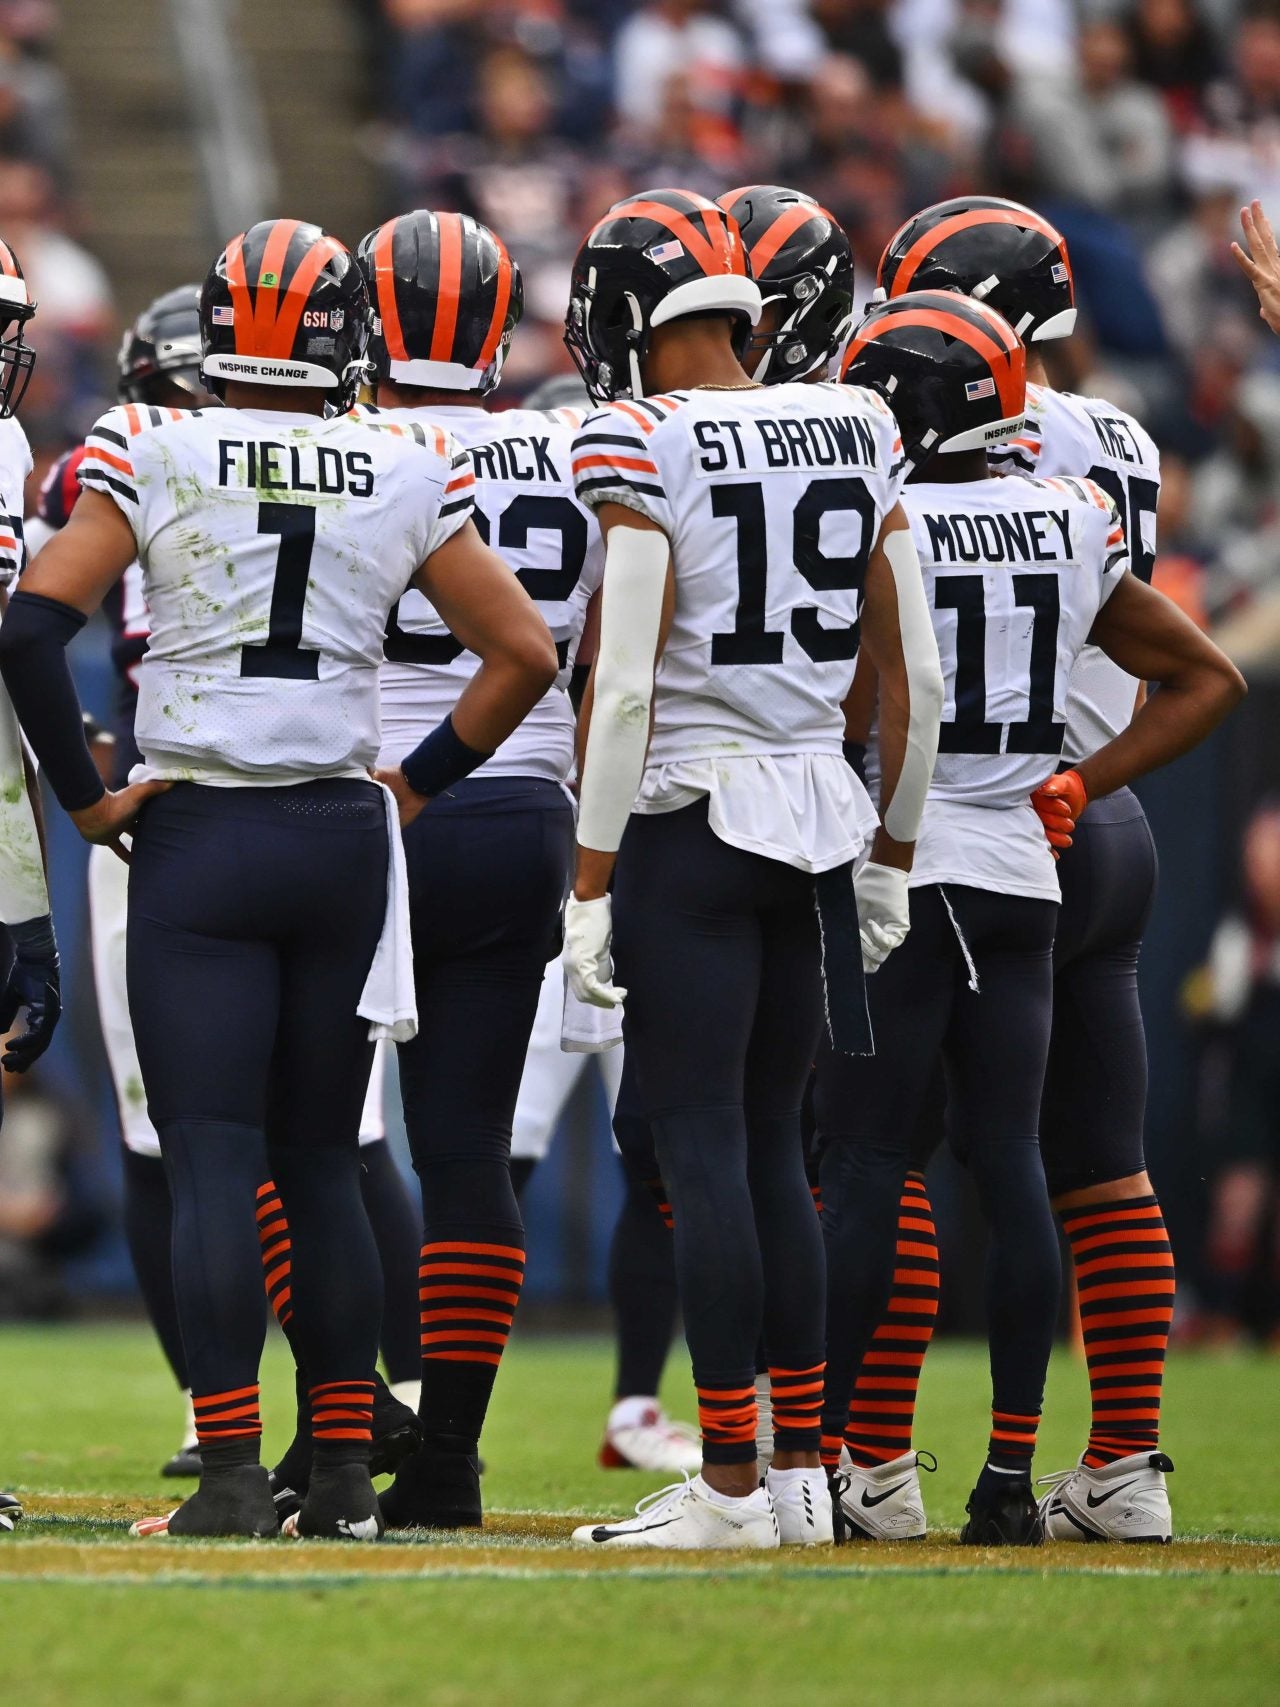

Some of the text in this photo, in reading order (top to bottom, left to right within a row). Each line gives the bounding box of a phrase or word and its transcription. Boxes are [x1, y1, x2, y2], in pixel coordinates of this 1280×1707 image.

[303, 311, 328, 328] GSH
[218, 362, 309, 380] INSPIRE CHANGE
[693, 416, 876, 471] ST BROWN
[984, 423, 1018, 440] INSPIRE
[219, 439, 374, 498] FIELDS
[465, 436, 561, 482] RICK
[922, 509, 1073, 562] MOONEY
[240, 501, 320, 680] 1
[710, 477, 876, 665] 19
[934, 573, 1067, 754] 11
